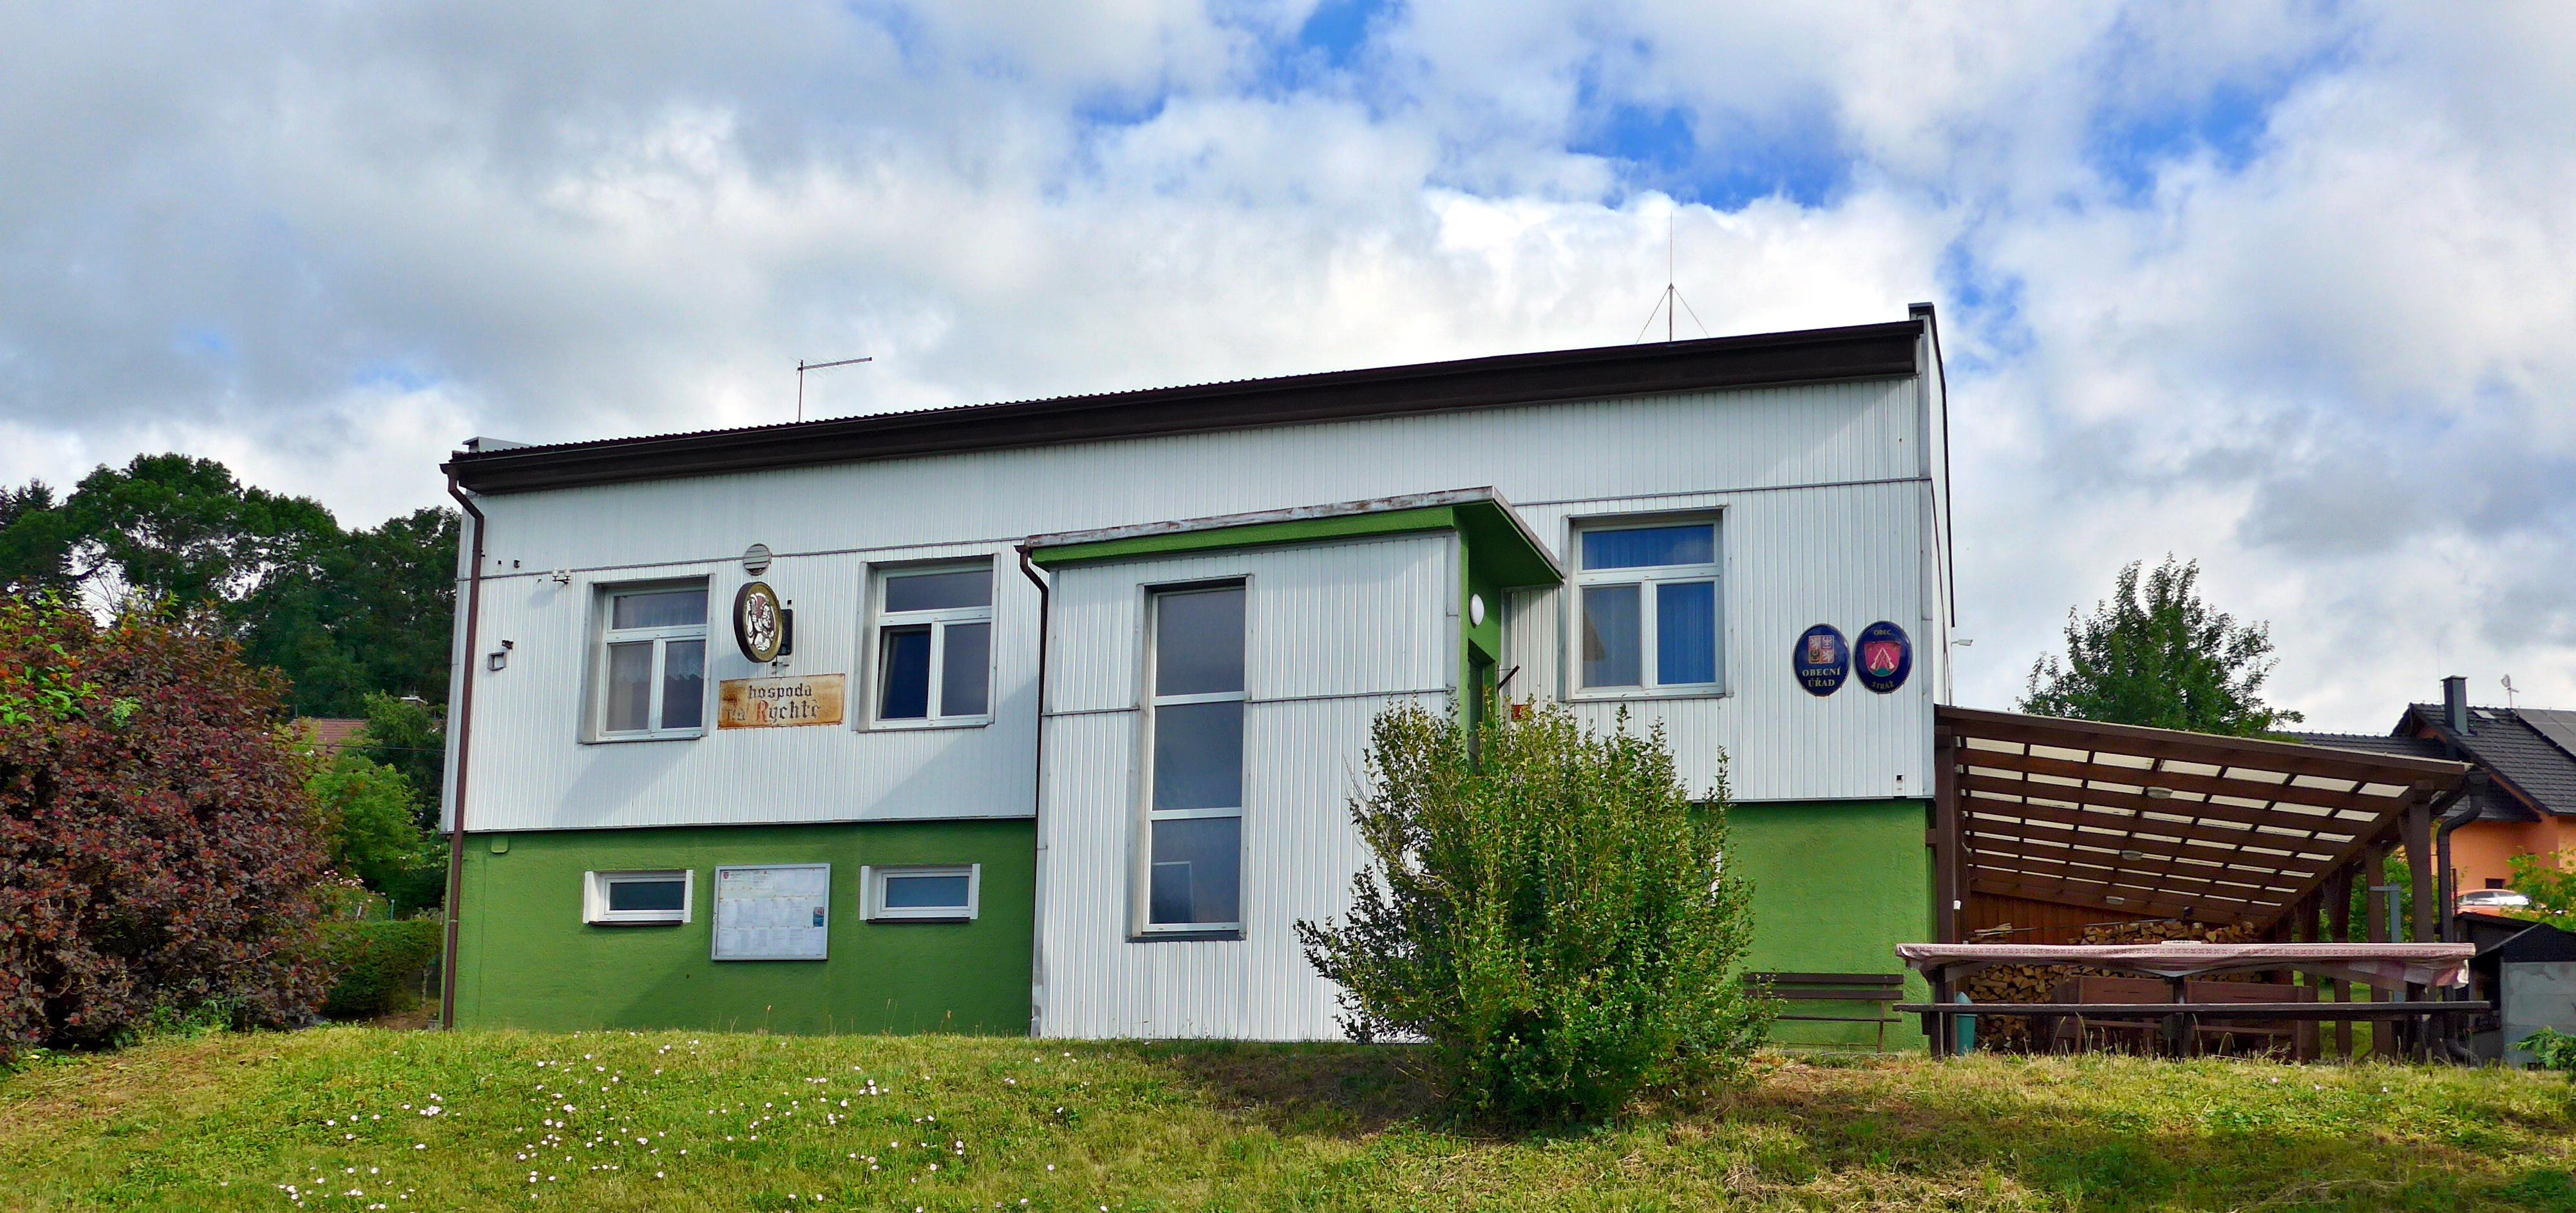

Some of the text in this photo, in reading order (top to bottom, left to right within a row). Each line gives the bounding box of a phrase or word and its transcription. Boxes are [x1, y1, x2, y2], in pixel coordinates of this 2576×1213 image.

[1802, 666, 1841, 676] OBECNÍ
[1808, 678, 1835, 687] ÚŘAD
[748, 682, 812, 701] hospoda
